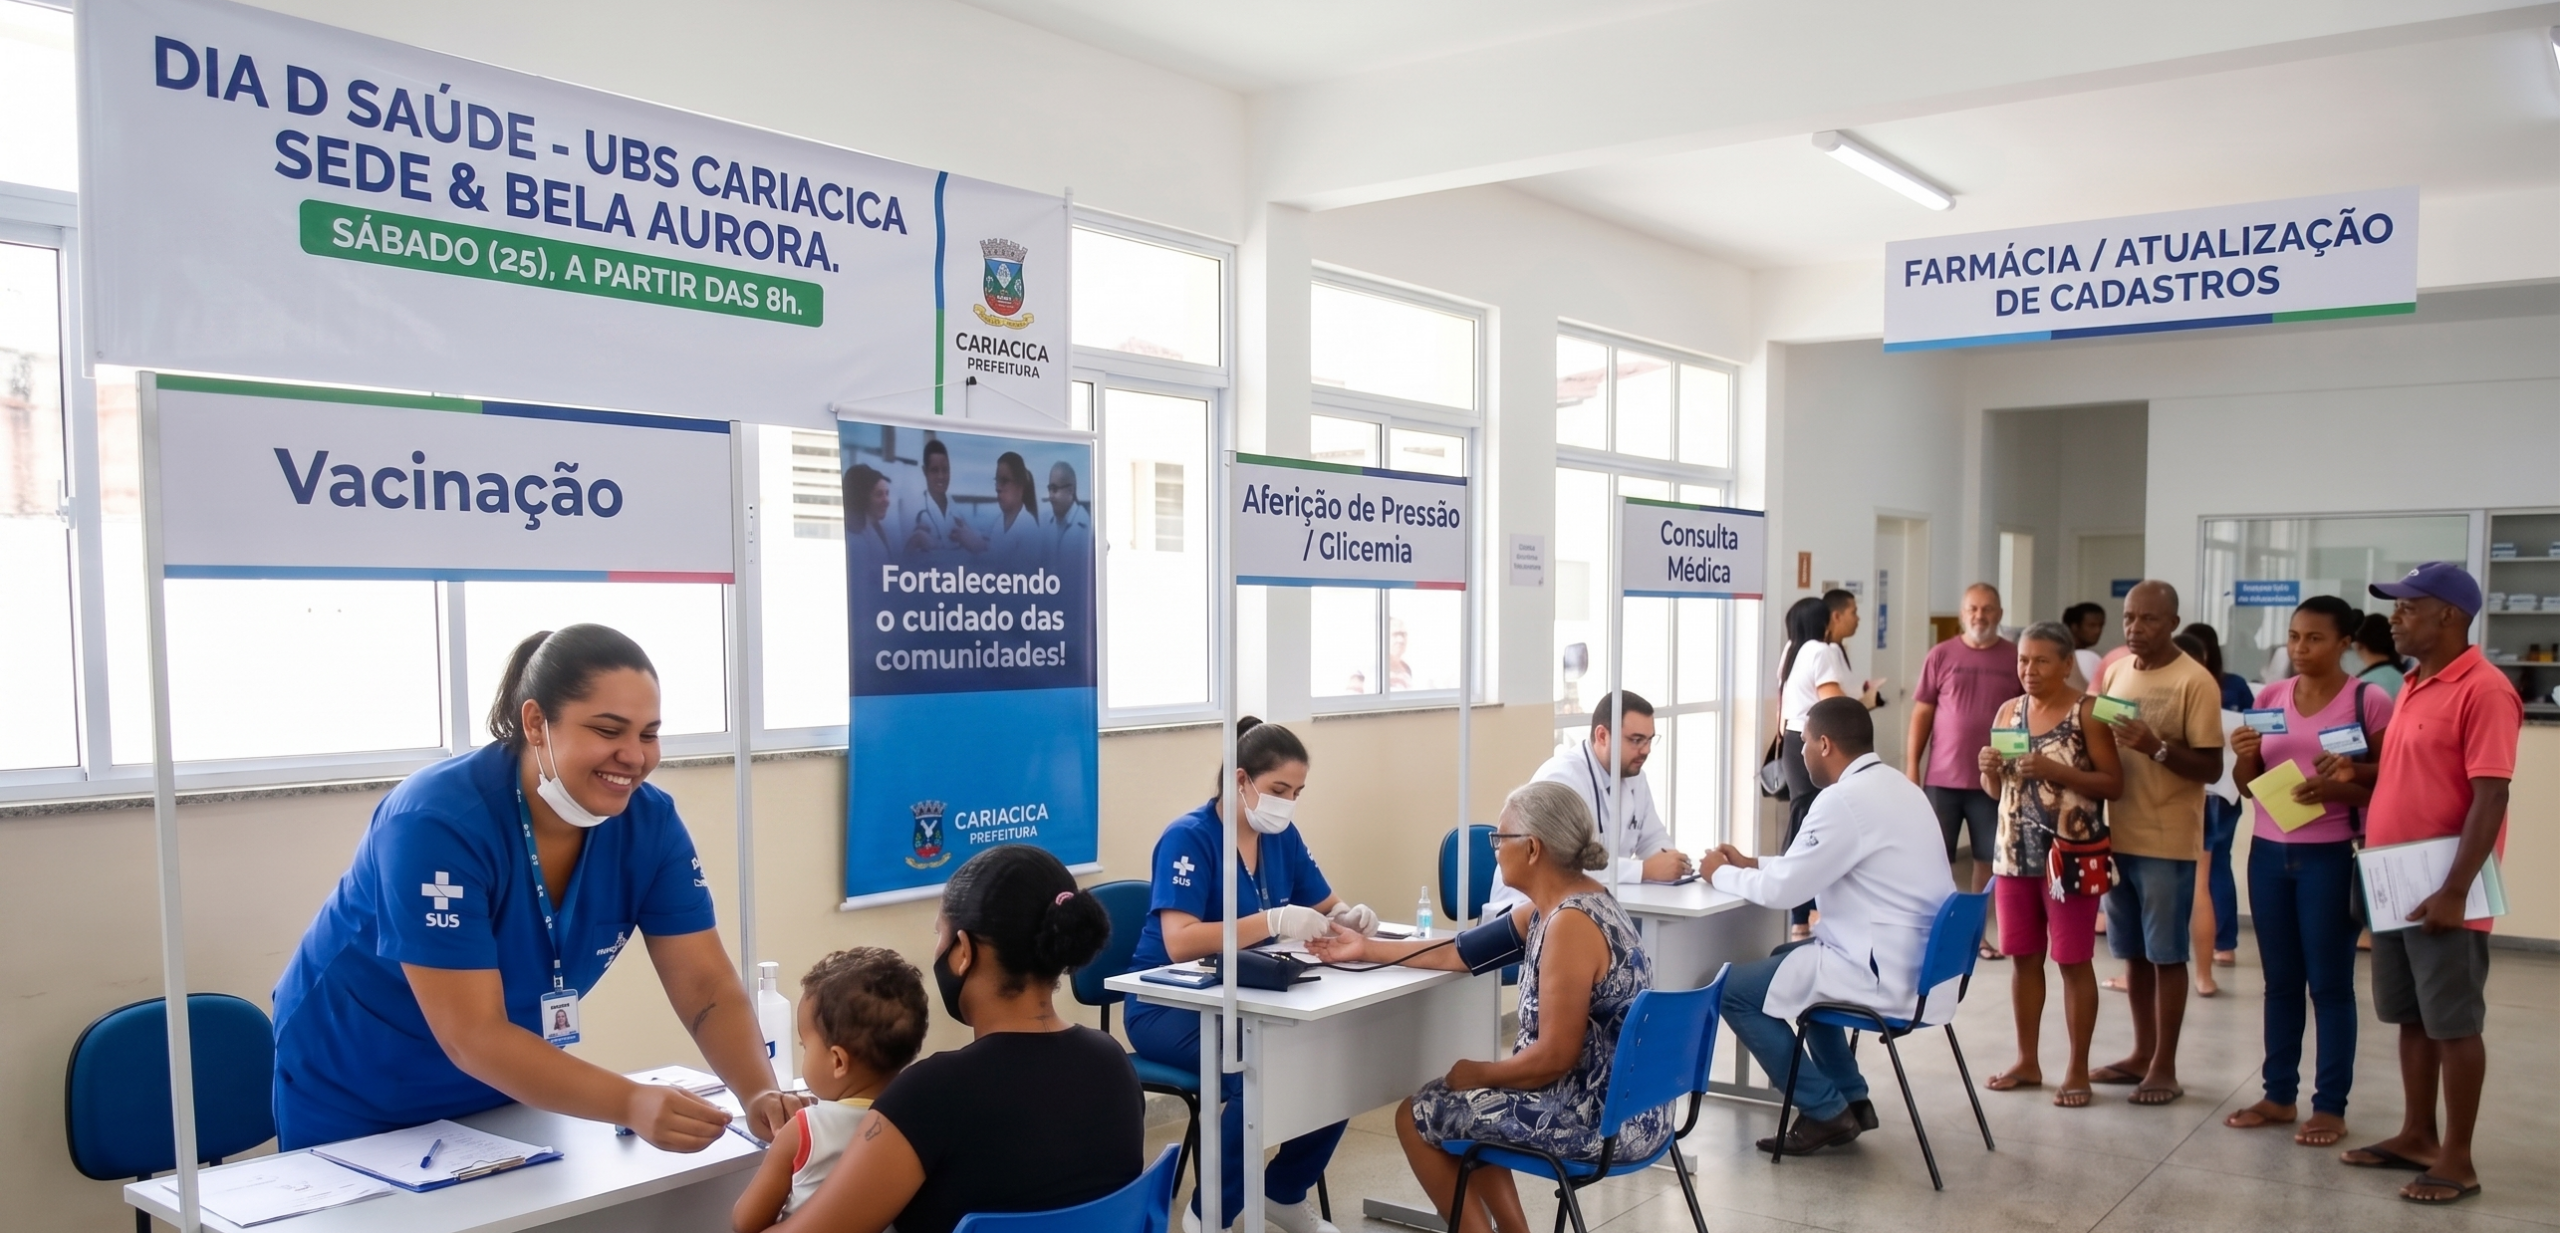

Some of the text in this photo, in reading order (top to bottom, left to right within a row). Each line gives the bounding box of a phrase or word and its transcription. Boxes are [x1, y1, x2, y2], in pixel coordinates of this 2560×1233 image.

[154, 36, 908, 235] DIA D SAÚDE - UBS CARIACICA
[274, 129, 840, 273] SEDE & BELA AURORA.
[1905, 206, 2394, 288] FARMÁCIA / ATUALIZAÇÃO
[332, 214, 803, 316] SÁBADO (25), A PARTIR DAS 8h.
[1996, 264, 2281, 317] DE CADASTROS
[955, 332, 1050, 363] CARIACICA
[967, 356, 1040, 379] PREFEITURA
[273, 447, 624, 531] Vacinação
[1241, 483, 1461, 529] Aferição de Pressão
[1302, 529, 1412, 564] / Glicemia
[1660, 519, 1738, 551] Consulta
[882, 564, 1061, 596] Fortalecendo
[1668, 556, 1731, 584] Médica
[876, 602, 1065, 632] o cuidado das
[875, 640, 1066, 672] comunidades!
[954, 803, 1049, 831] CARIACICA
[970, 825, 1038, 845] PREFEITURA
[1172, 875, 1191, 887] SUS
[425, 912, 460, 928] SUS
